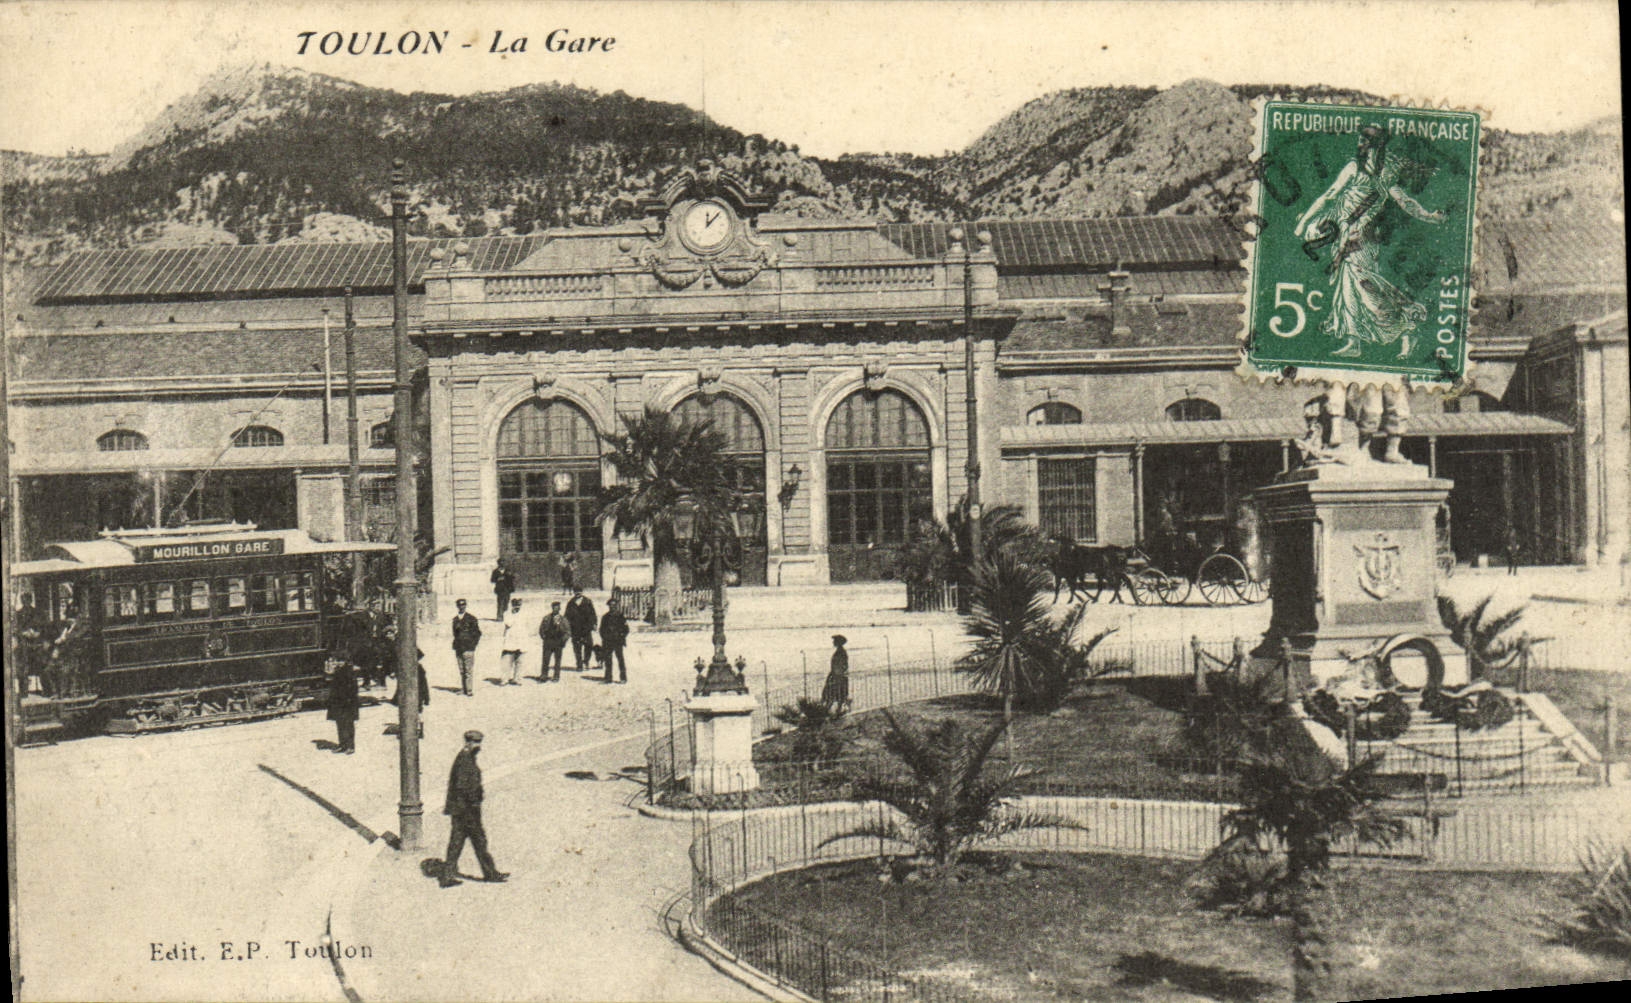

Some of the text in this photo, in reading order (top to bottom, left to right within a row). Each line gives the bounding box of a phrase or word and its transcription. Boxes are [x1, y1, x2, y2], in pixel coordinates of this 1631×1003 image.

[1272, 110, 1470, 142] REPUBLIQUE FRANÇAISE
[1436, 274, 1460, 360] POSTES
[152, 540, 270, 560] MOURILLON GARE
